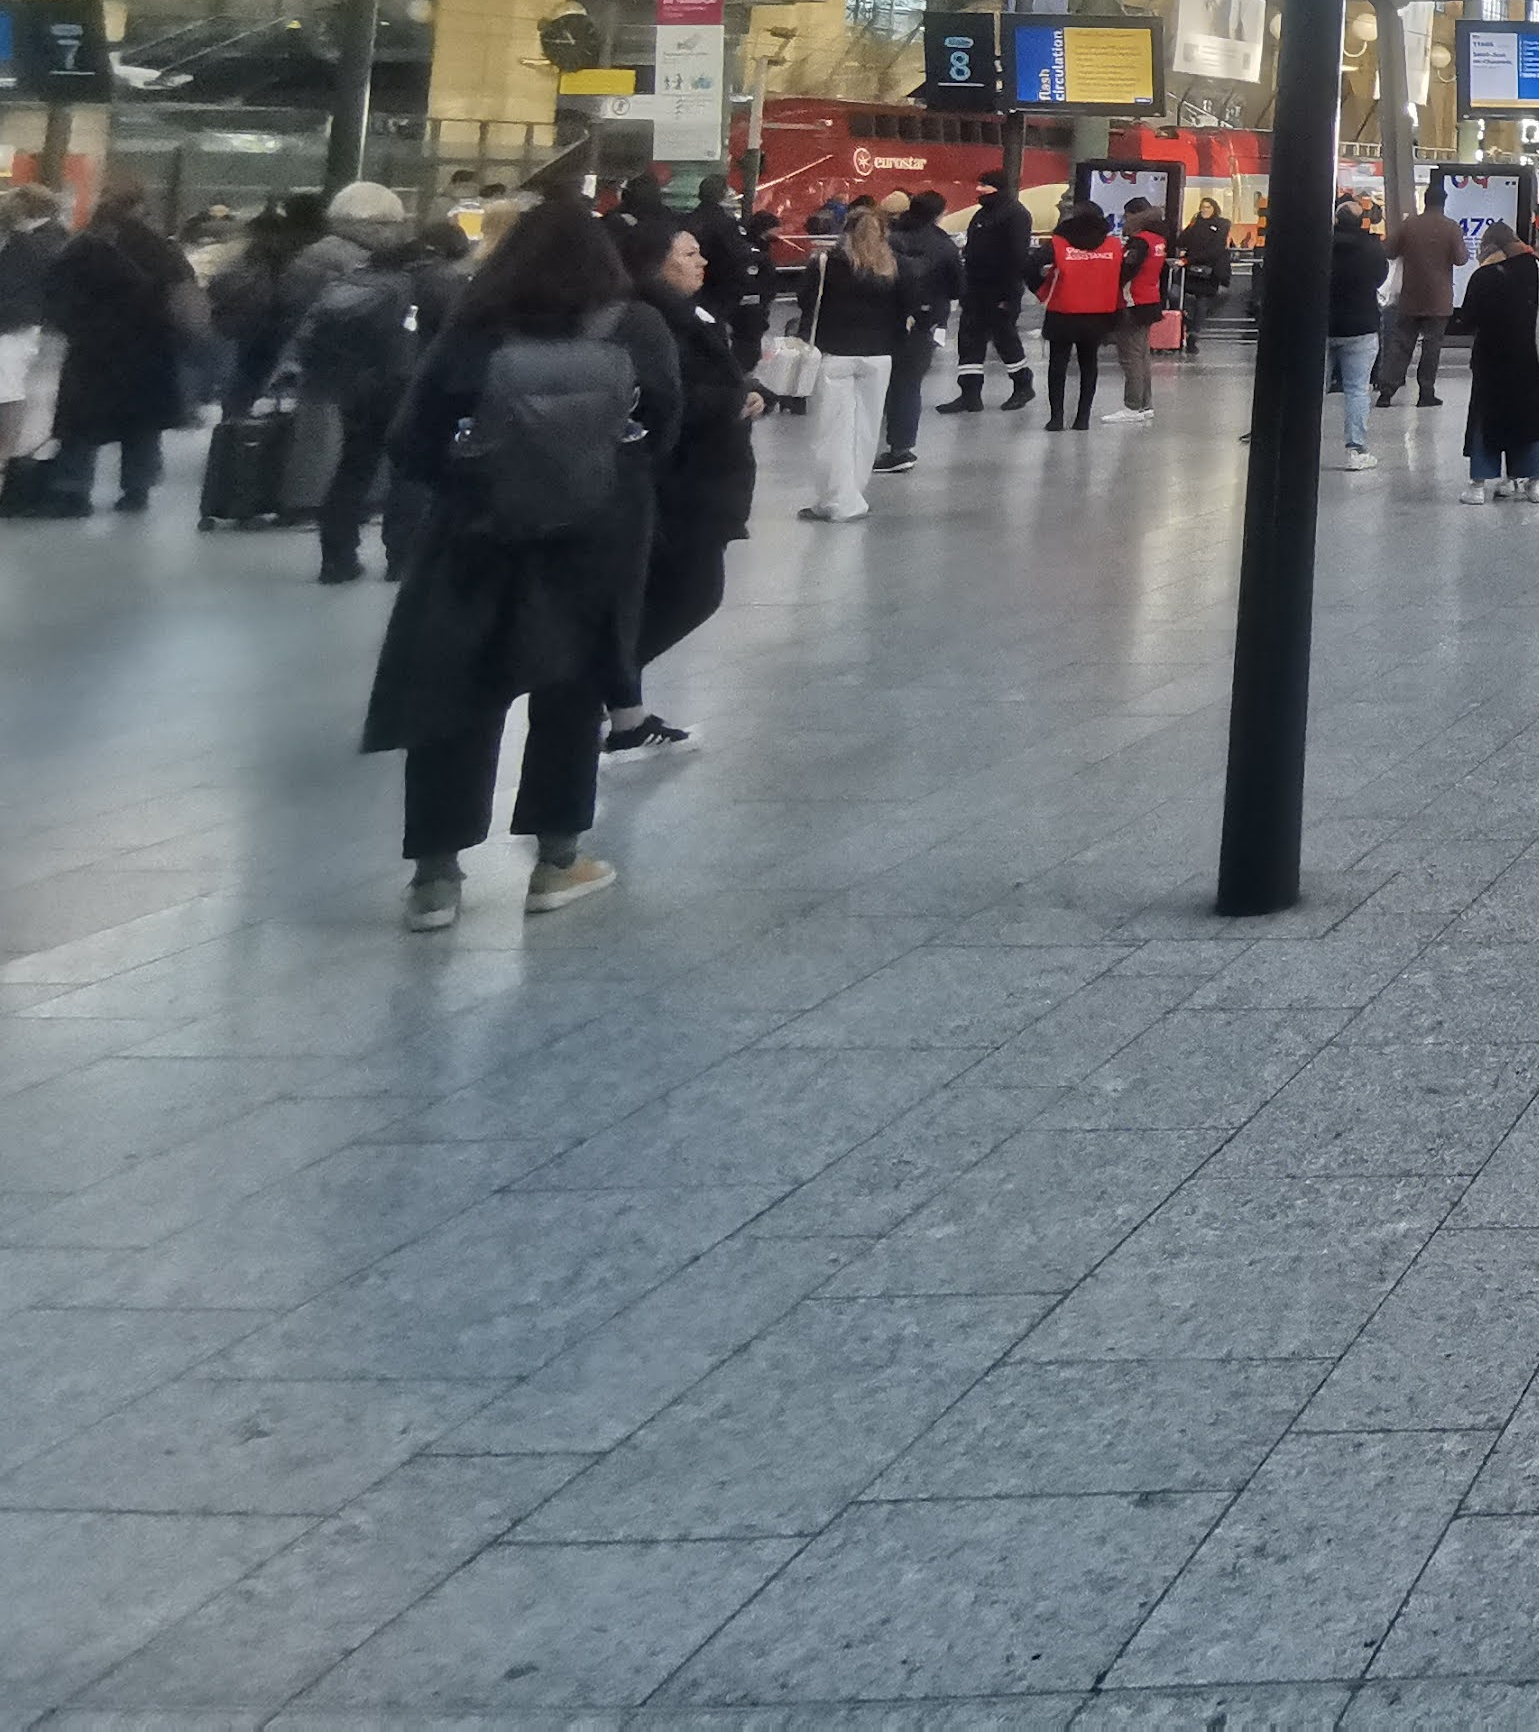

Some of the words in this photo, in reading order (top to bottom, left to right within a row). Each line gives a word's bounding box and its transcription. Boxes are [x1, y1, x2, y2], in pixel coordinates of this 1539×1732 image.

[949, 50, 971, 82] 8
[1051, 29, 1065, 102] circulation
[873, 155, 927, 170] eurostar
